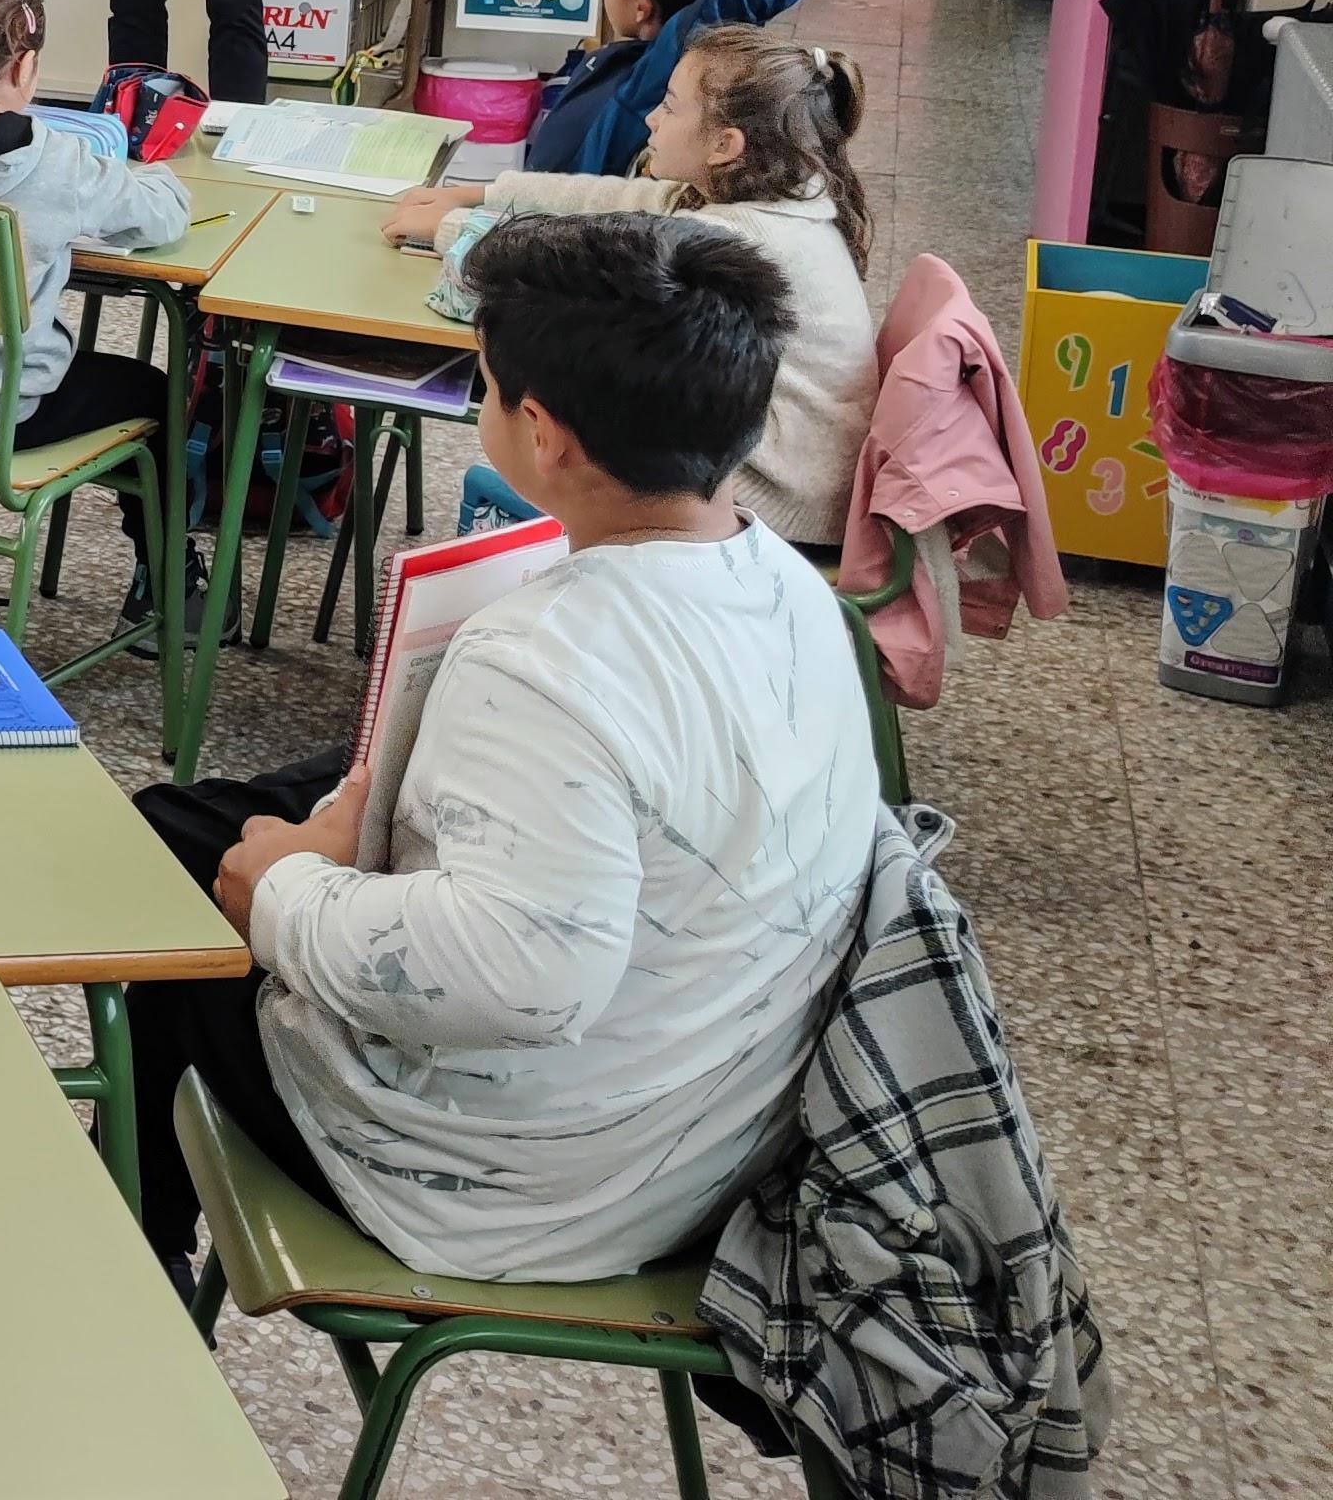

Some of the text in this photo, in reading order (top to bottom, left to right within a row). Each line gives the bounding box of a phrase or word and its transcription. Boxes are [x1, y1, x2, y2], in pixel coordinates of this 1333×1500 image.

[267, 28, 297, 51] A4
[1054, 332, 1129, 417] 9 1
[1041, 419, 1126, 515] 8 3
